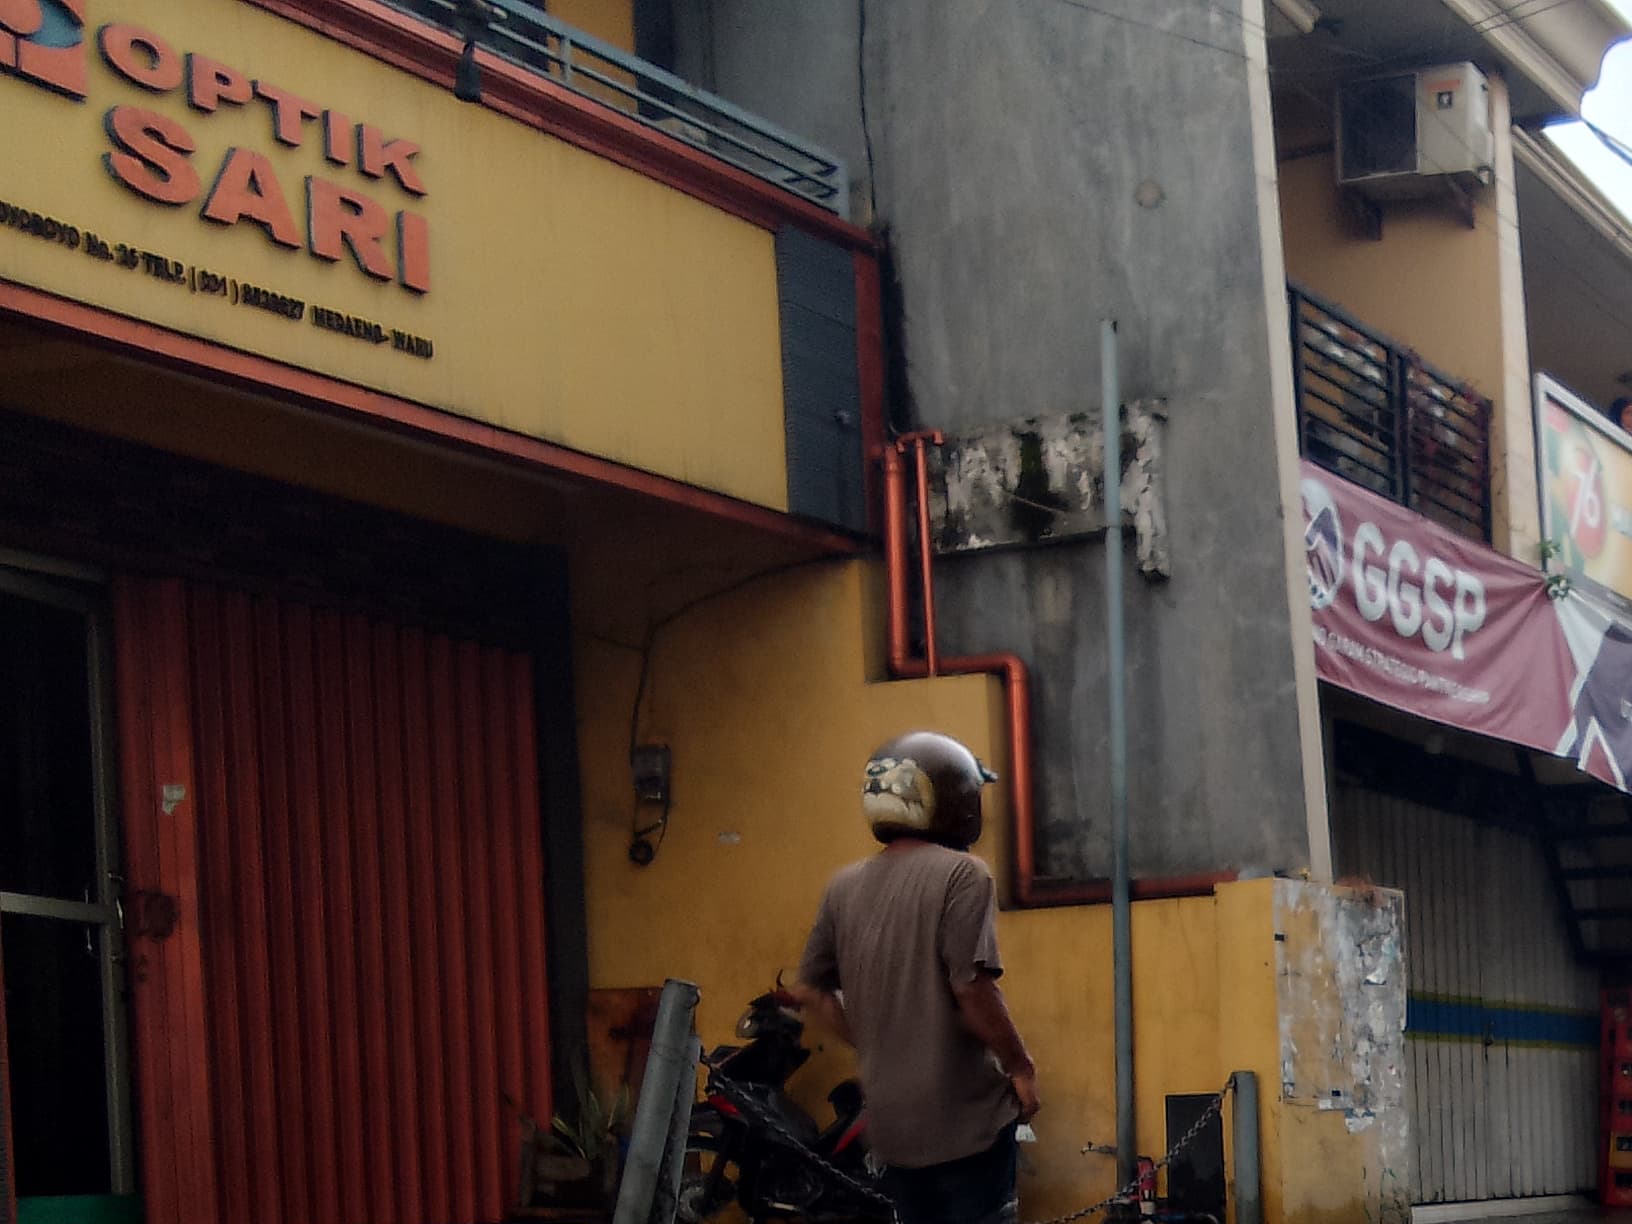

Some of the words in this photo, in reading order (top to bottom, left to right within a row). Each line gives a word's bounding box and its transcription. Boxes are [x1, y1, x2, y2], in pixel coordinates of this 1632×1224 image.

[98, 23, 429, 197] OPTIK
[103, 104, 431, 295] SARI
[1352, 521, 1486, 661] GGSP
